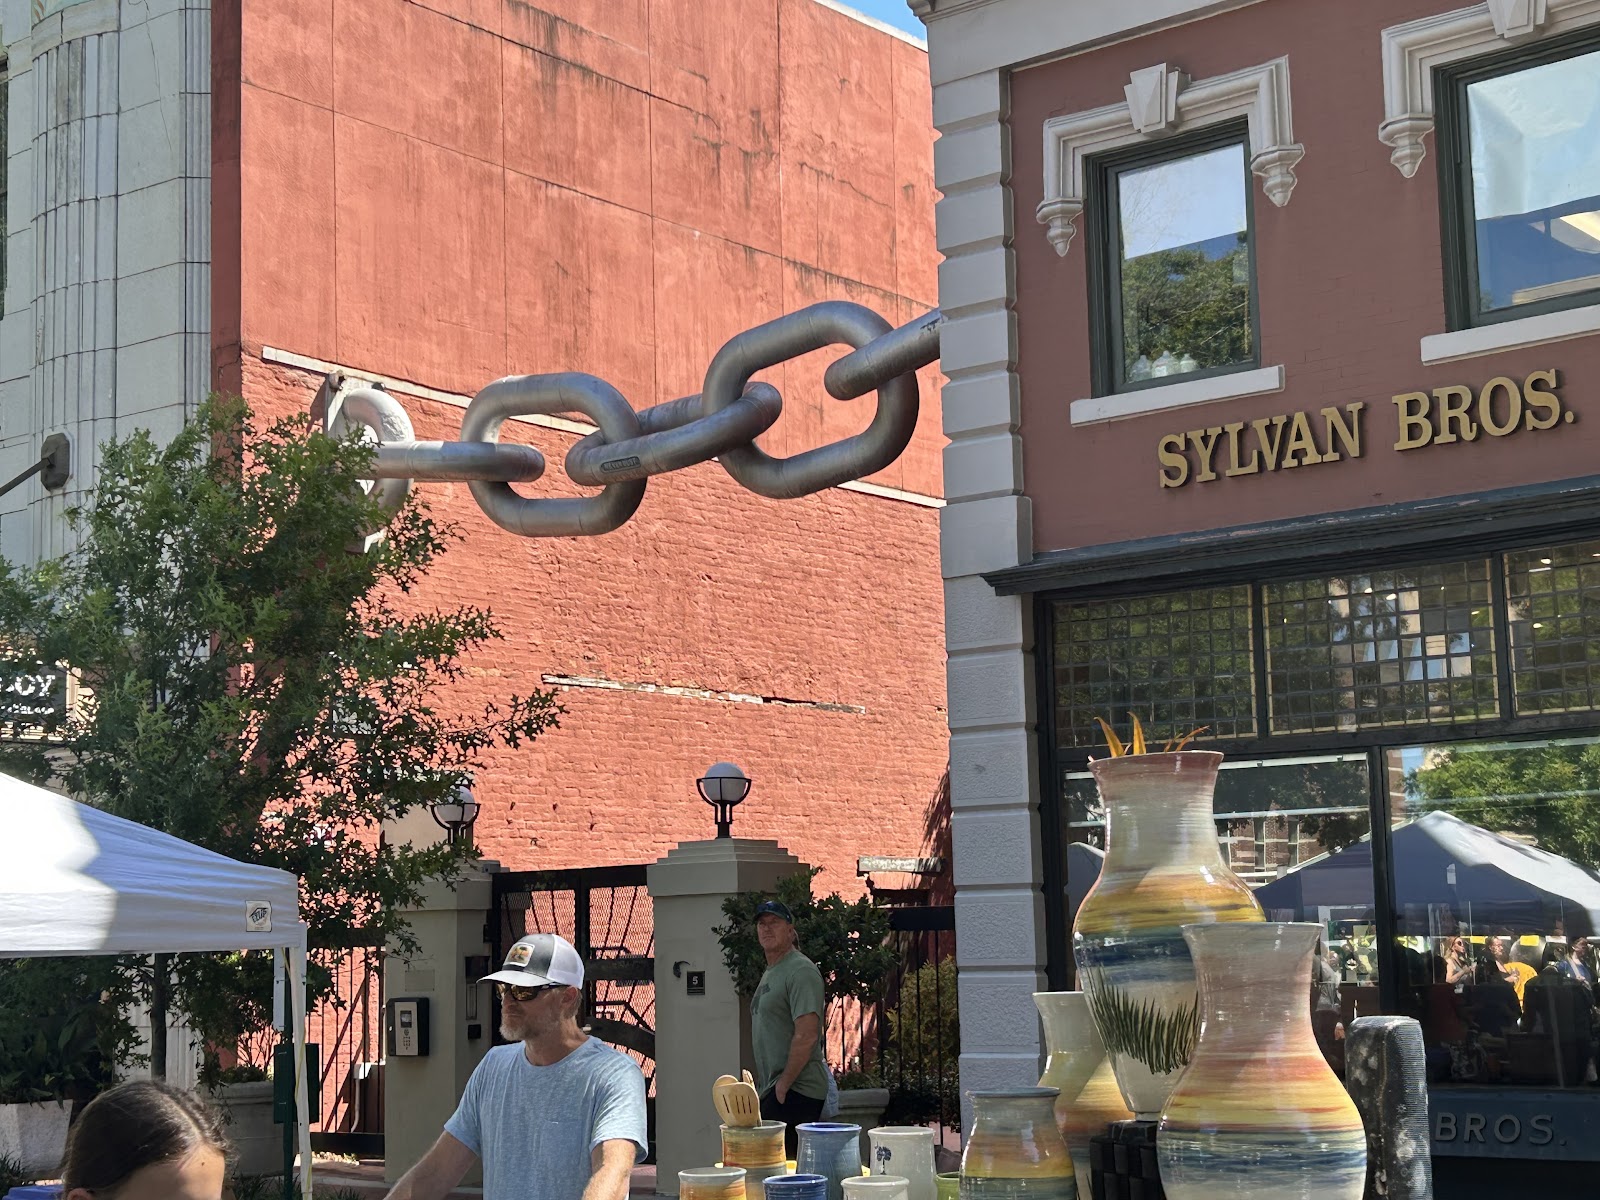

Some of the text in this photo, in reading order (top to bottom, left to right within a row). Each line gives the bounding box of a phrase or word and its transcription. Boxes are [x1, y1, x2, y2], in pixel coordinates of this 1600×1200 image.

[1157, 368, 1575, 488] SYLVAN BROS.
[0, 674, 56, 697] OY
[692, 975, 699, 985] 5
[1434, 1111, 1568, 1146] BROS.
